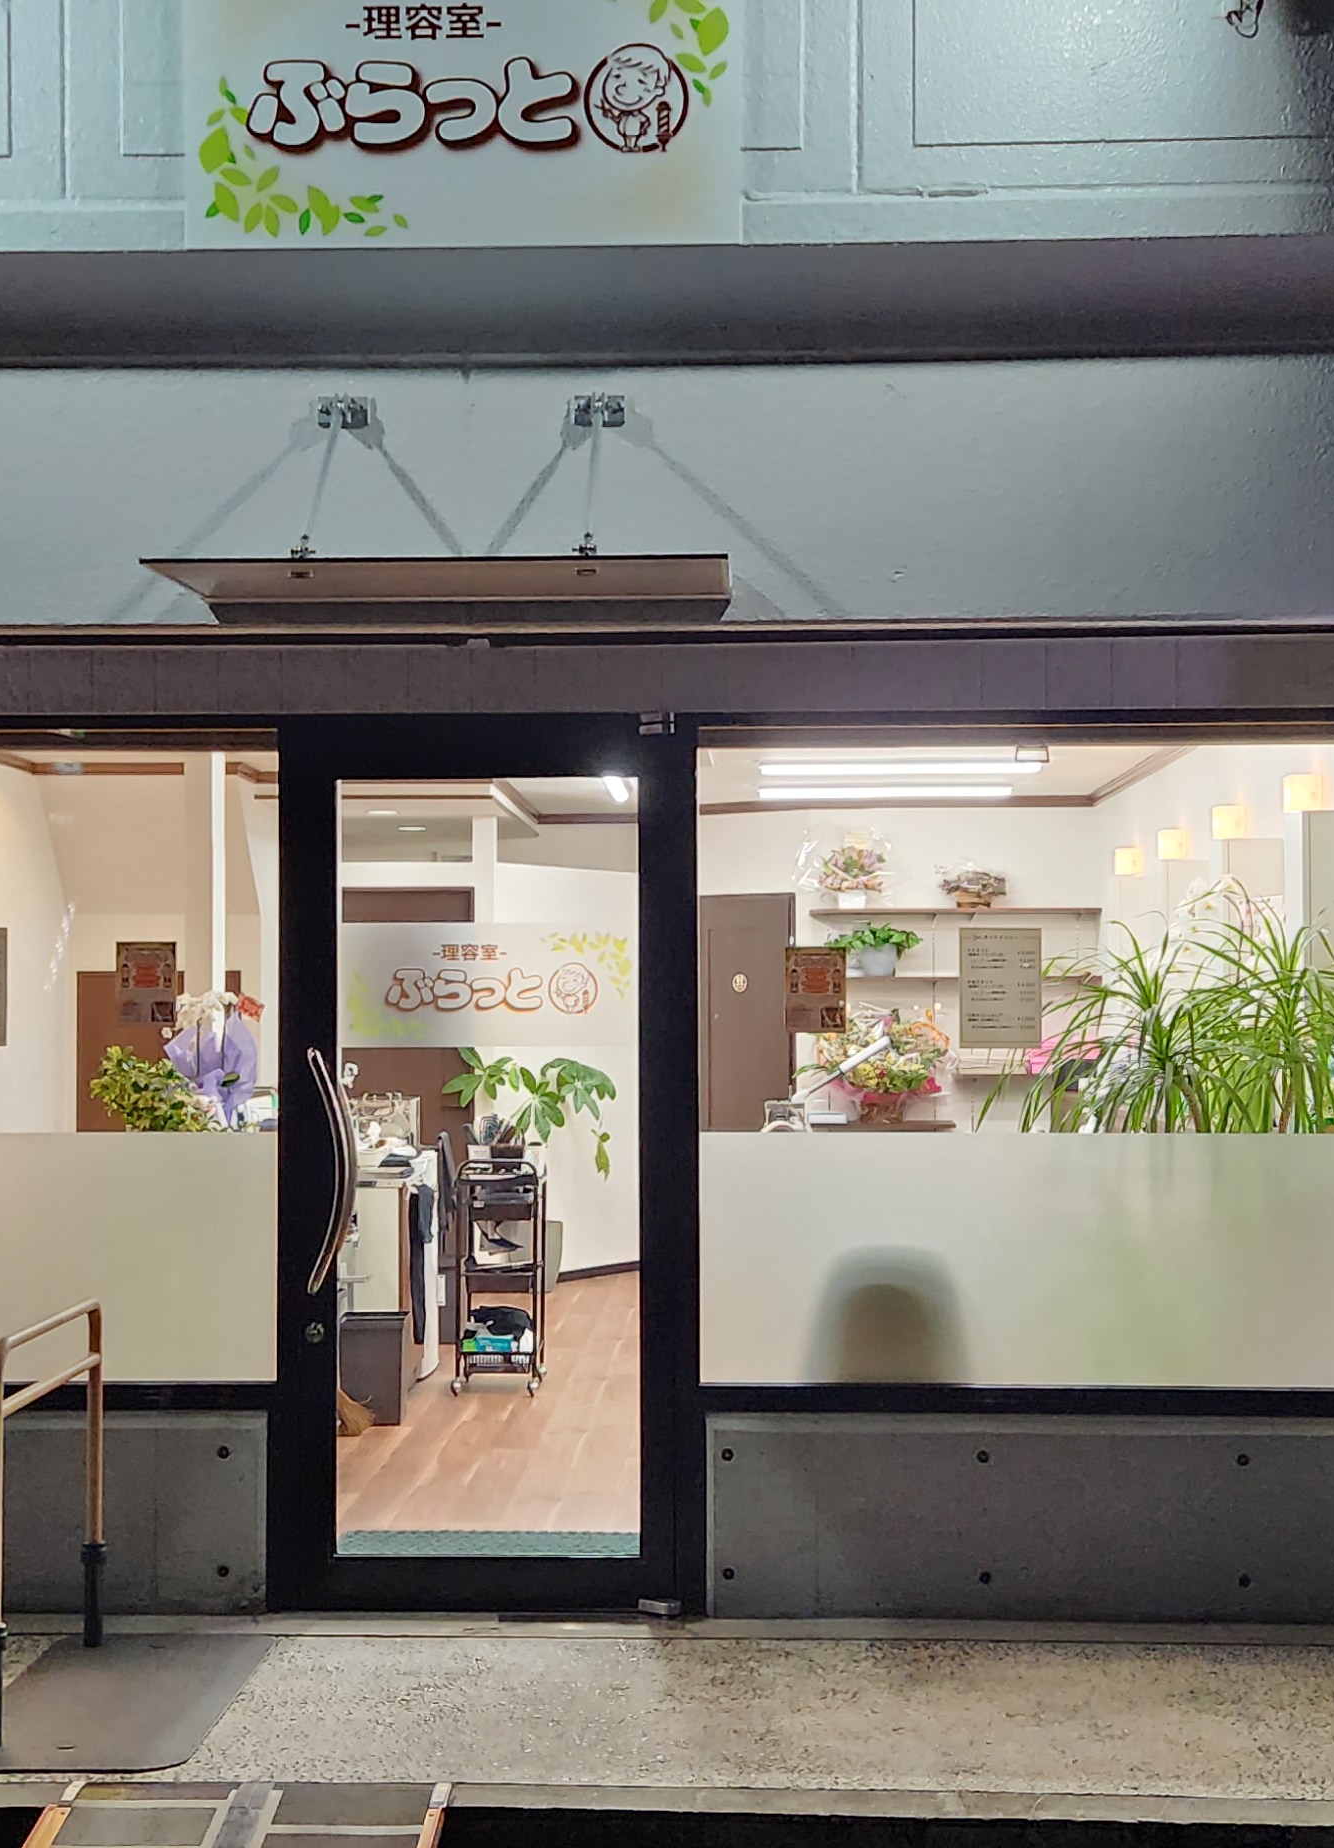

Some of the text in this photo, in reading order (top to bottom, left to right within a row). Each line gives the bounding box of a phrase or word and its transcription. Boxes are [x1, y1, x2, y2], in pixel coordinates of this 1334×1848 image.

[246, 56, 583, 154] ぶらっと
[385, 967, 544, 1013] ぶらっと
